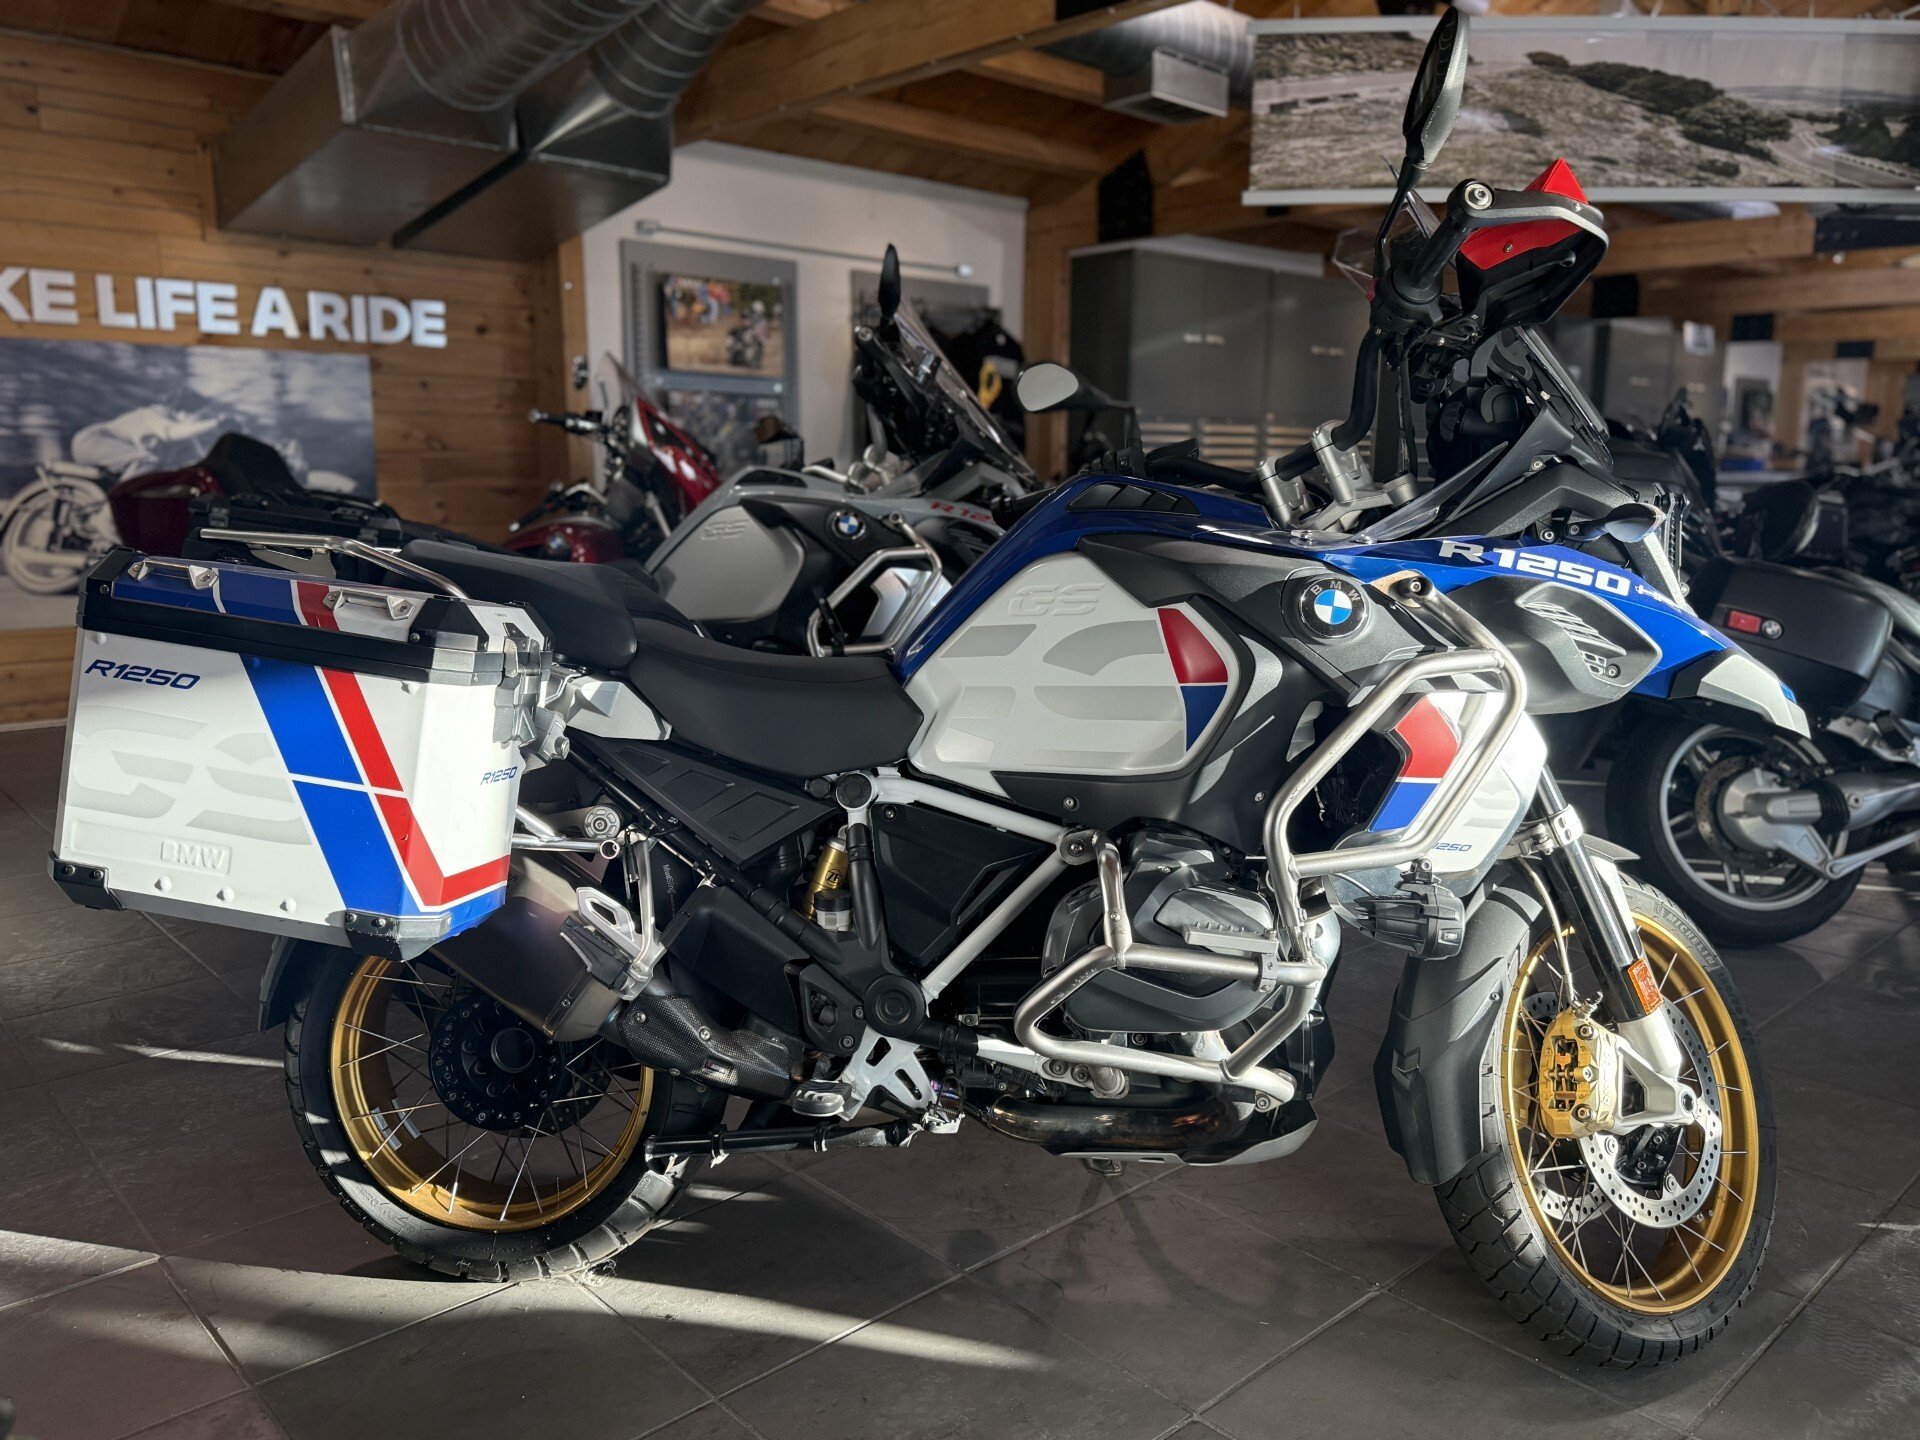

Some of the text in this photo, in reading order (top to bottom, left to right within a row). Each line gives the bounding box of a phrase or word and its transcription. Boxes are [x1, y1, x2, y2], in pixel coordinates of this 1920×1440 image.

[94, 273, 241, 336] LIFE
[250, 286, 300, 339] A
[307, 290, 448, 348] RIDE
[1008, 583, 1106, 617] GS
[1310, 580, 1361, 602] BMW
[84, 659, 201, 690] R1250
[480, 765, 518, 785] R1250
[160, 841, 229, 871] BMW
[1664, 910, 1720, 968] MICHELIN
